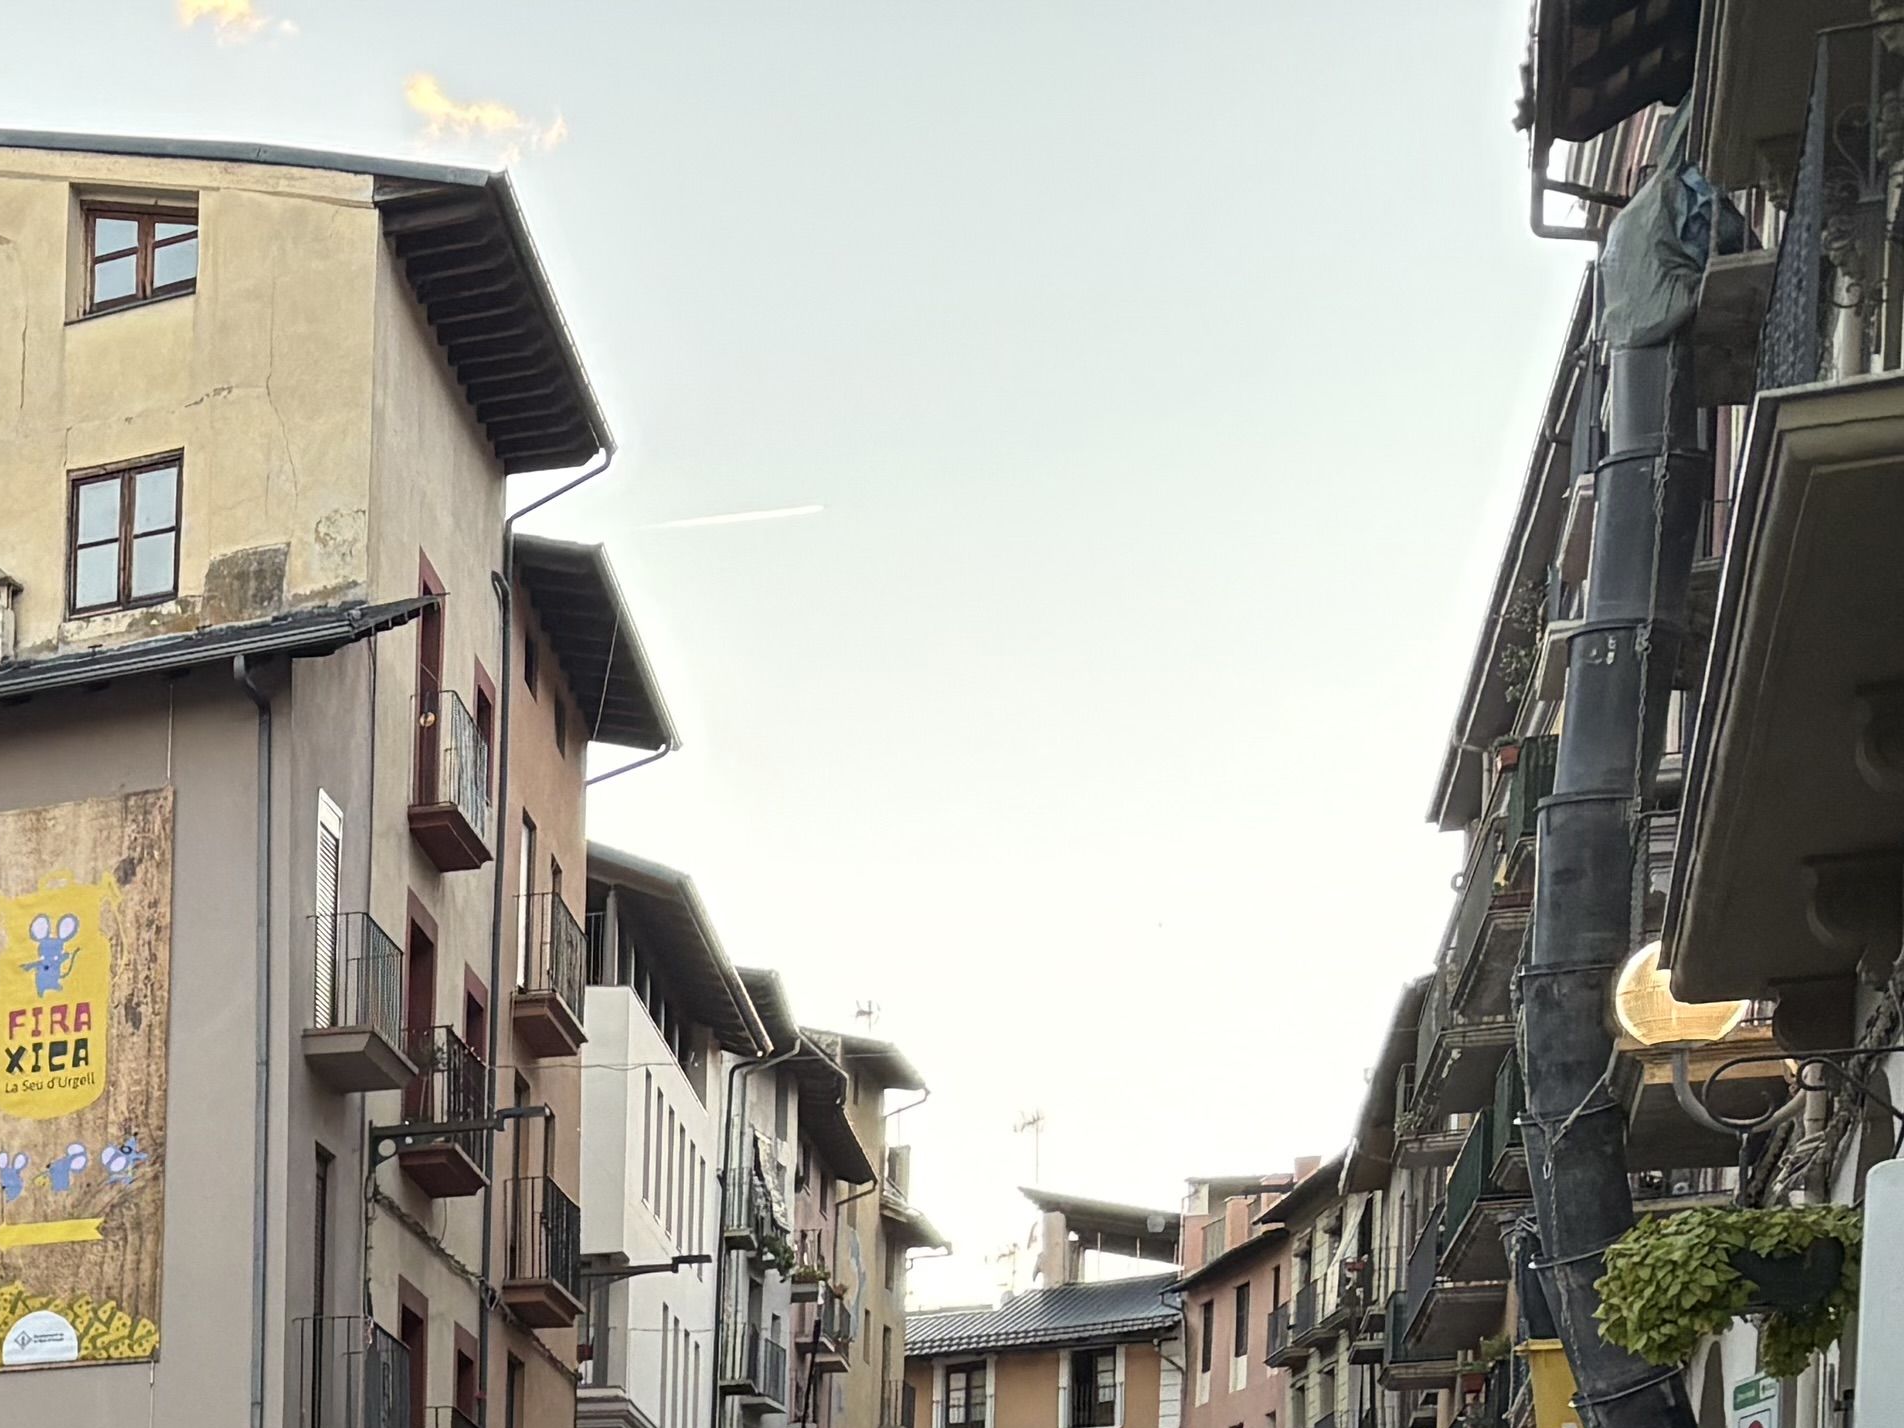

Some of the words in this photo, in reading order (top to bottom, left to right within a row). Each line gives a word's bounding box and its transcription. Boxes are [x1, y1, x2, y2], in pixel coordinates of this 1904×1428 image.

[9, 1002, 92, 1040] FIRA
[5, 1038, 89, 1074] XICA
[5, 1082, 18, 1094] La
[22, 1080, 43, 1092] Seu
[47, 1072, 95, 1090] d'Urgell
